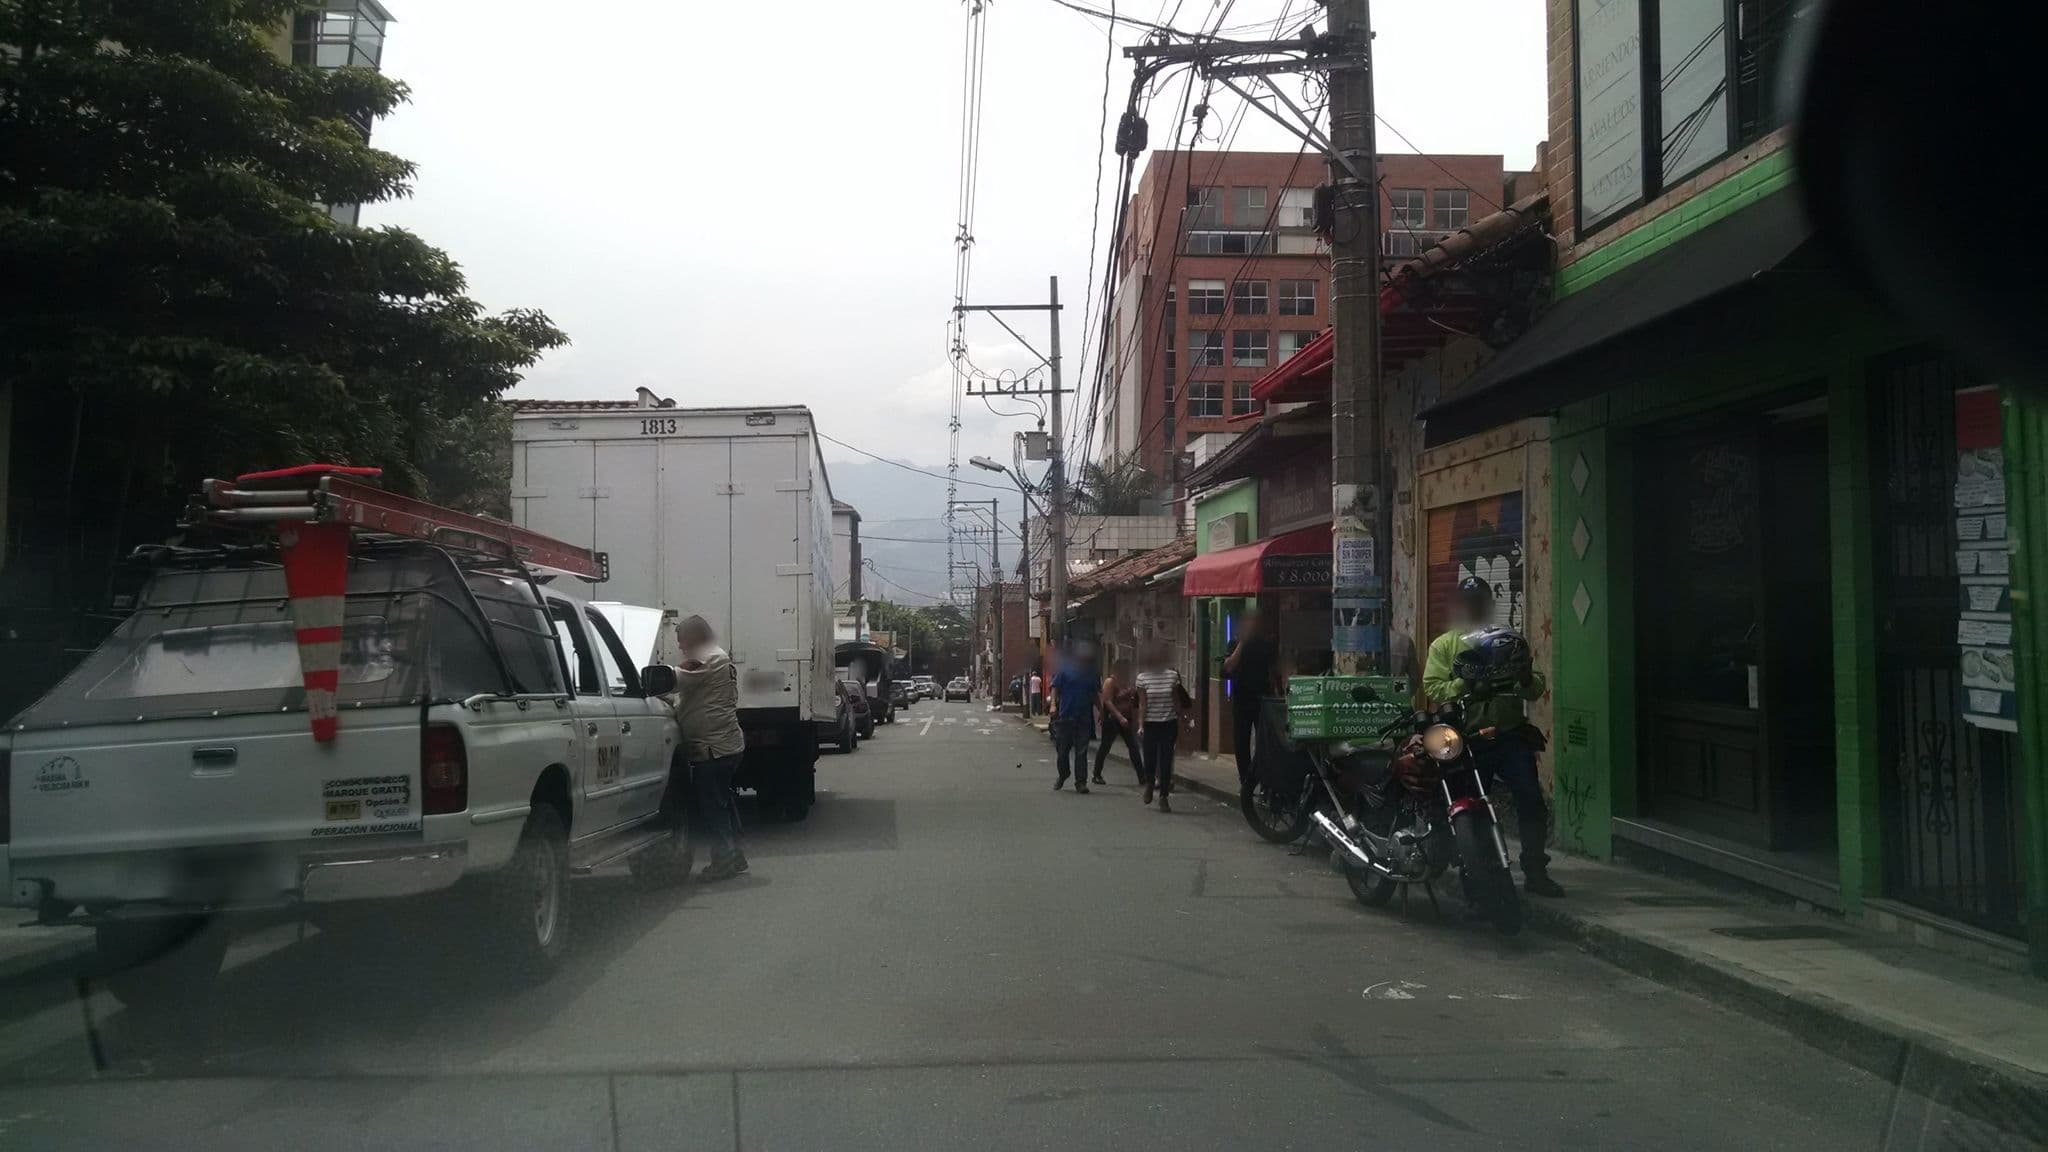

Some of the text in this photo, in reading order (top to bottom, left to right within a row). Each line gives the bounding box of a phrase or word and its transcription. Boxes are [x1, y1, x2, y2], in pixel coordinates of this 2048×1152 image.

[1582, 32, 1641, 88] ARRIENDOS
[1592, 158, 1633, 198] VENTAS
[640, 419, 677, 435] 1813
[1333, 726, 1343, 734] 01
[325, 785, 408, 798] MARQUE GRATIS
[369, 822, 418, 833] NACIONAL
